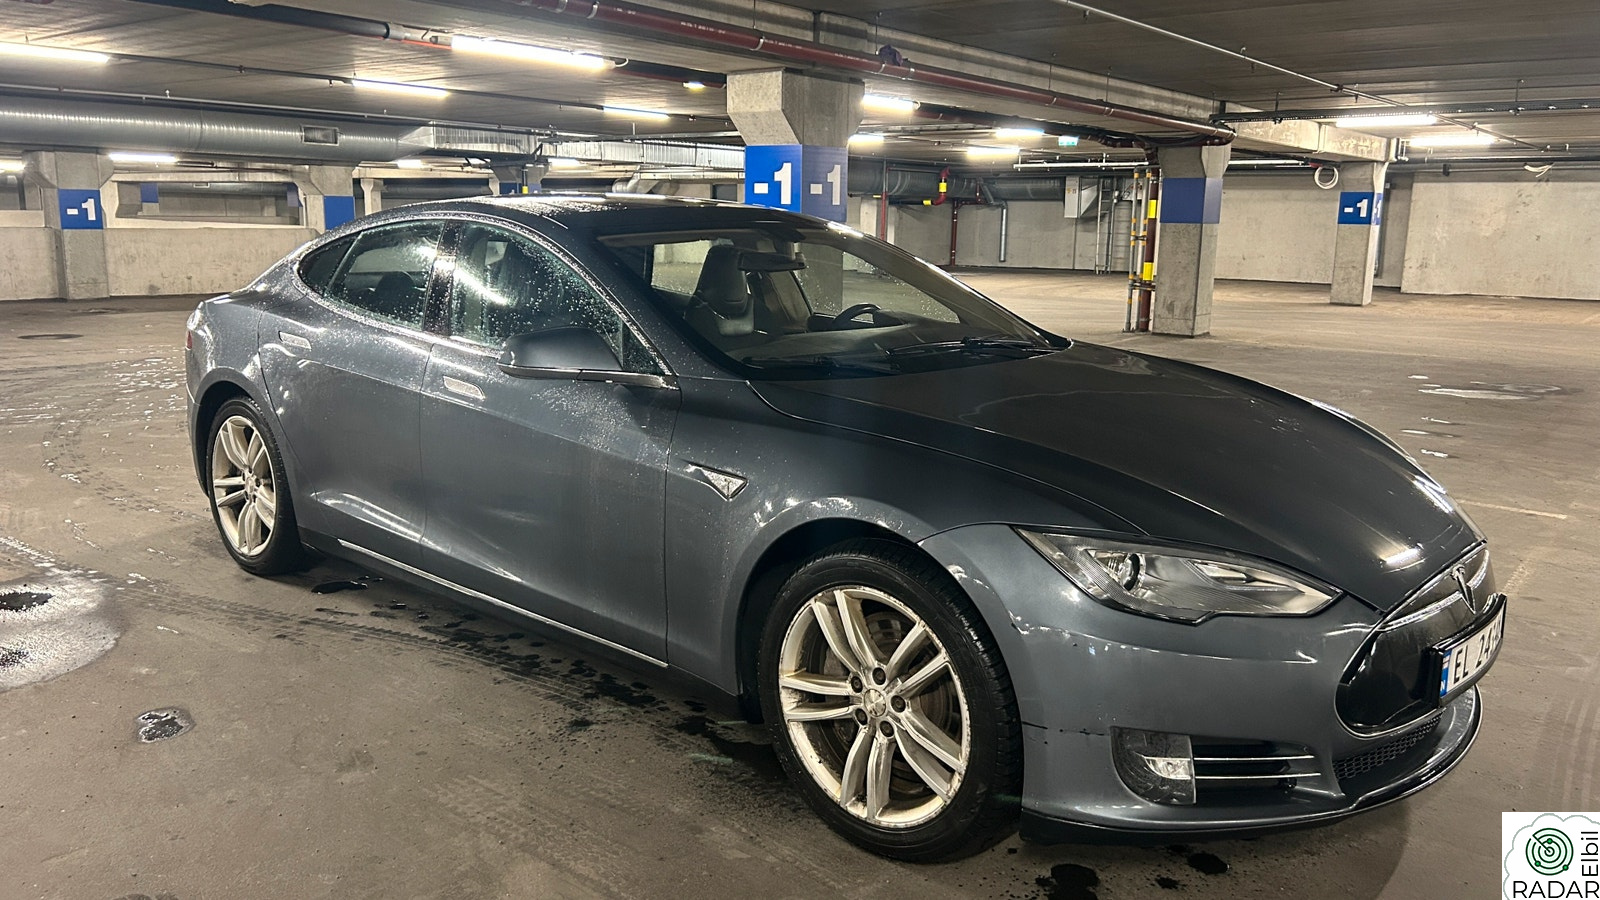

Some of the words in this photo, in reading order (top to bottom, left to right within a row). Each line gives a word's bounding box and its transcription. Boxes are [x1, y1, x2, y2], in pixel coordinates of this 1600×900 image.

[754, 162, 792, 205] -1
[810, 164, 841, 206] -1
[66, 198, 96, 221] -1
[1343, 198, 1368, 218] -1
[1453, 644, 1469, 684] EL
